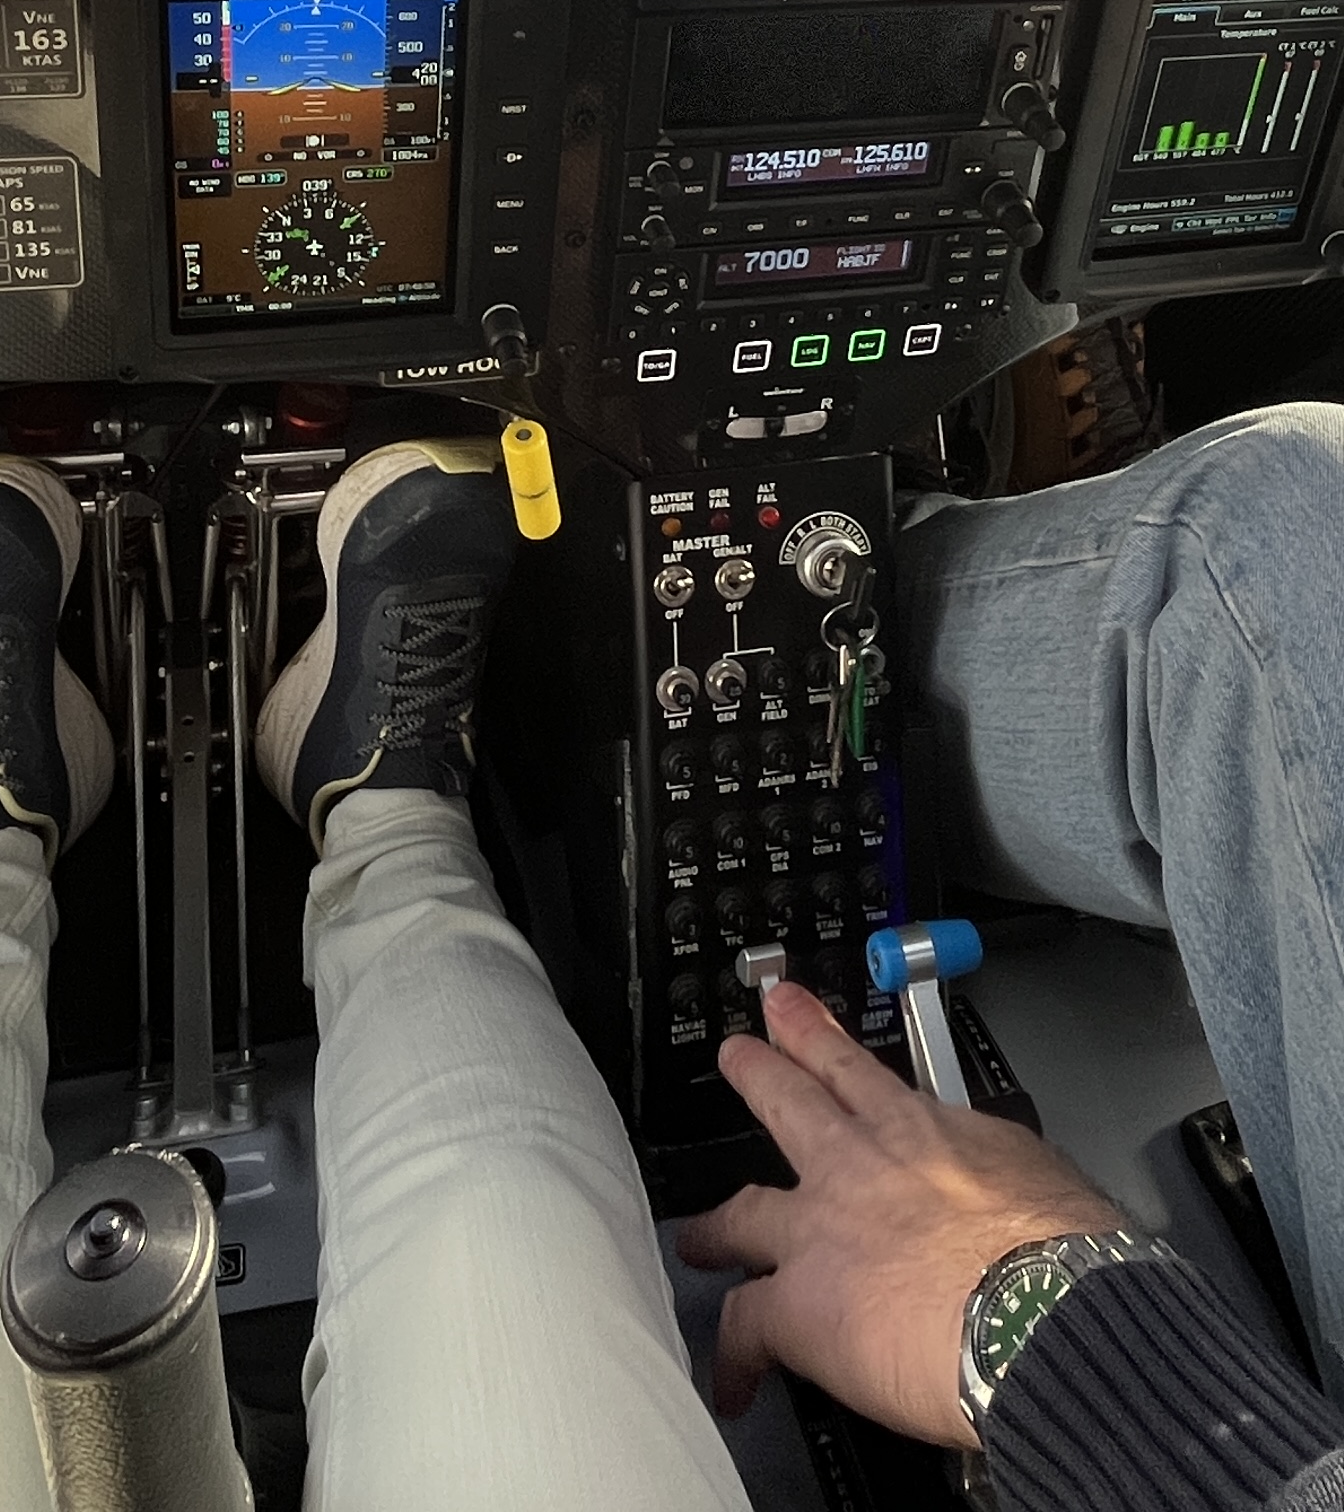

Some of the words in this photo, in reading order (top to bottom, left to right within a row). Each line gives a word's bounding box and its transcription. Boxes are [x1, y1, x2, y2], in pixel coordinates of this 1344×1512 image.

[1244, 9, 1262, 19] Aux
[1300, 6, 1320, 16] Fuel
[1321, 5, 1340, 15] Calc
[193, 12, 212, 25] 50
[1174, 13, 1197, 23] Main
[194, 33, 212, 45] 40
[1221, 28, 1278, 39] Temperature
[14, 29, 69, 51] 163
[398, 41, 423, 53] 500
[22, 54, 62, 67] KTAS
[194, 54, 212, 66] 30
[502, 104, 527, 114] NRST
[854, 142, 928, 164] 125.610
[744, 149, 821, 172] 124.510
[822, 148, 842, 158] COM
[30, 164, 64, 174] SPEED
[10, 196, 36, 212] 65
[496, 199, 524, 209] MENU
[1111, 203, 1142, 214] Engine
[1143, 200, 1169, 210] Hours
[303, 209, 312, 219] 3
[324, 209, 334, 219] 6
[848, 215, 870, 223] FUNC
[12, 219, 37, 235] 81
[1130, 222, 1160, 234] Engine
[266, 232, 284, 243] 33
[348, 234, 364, 245] 12
[15, 242, 51, 257] 135
[264, 250, 281, 261] 30
[346, 251, 362, 262] 15
[744, 248, 810, 273] 7000
[291, 275, 308, 286] 24
[312, 274, 329, 286] 21
[821, 398, 834, 410] R
[728, 405, 739, 419] L
[709, 488, 729, 498] GEN
[758, 483, 776, 493] ALT
[650, 492, 695, 504] BATTERY
[651, 502, 694, 515] CAUTION
[820, 516, 846, 529] BOTH
[845, 524, 867, 551] START
[673, 535, 731, 552] MASTER
[663, 552, 683, 563] BAT
[726, 601, 744, 612] OFF
[665, 608, 684, 620] OFF
[765, 700, 783, 710] ALT
[717, 712, 737, 723] GEN
[761, 709, 788, 721] FIELD
[668, 719, 688, 729] BAT
[864, 836, 883, 847] NAV
[813, 844, 834, 855] COM
[835, 842, 841, 852] 2
[770, 851, 790, 863] GPS
[717, 861, 739, 871] COM
[741, 858, 746, 867] 1
[668, 866, 698, 879] AUDIO
[816, 918, 844, 931] STALL
[867, 996, 892, 1007] COOL
